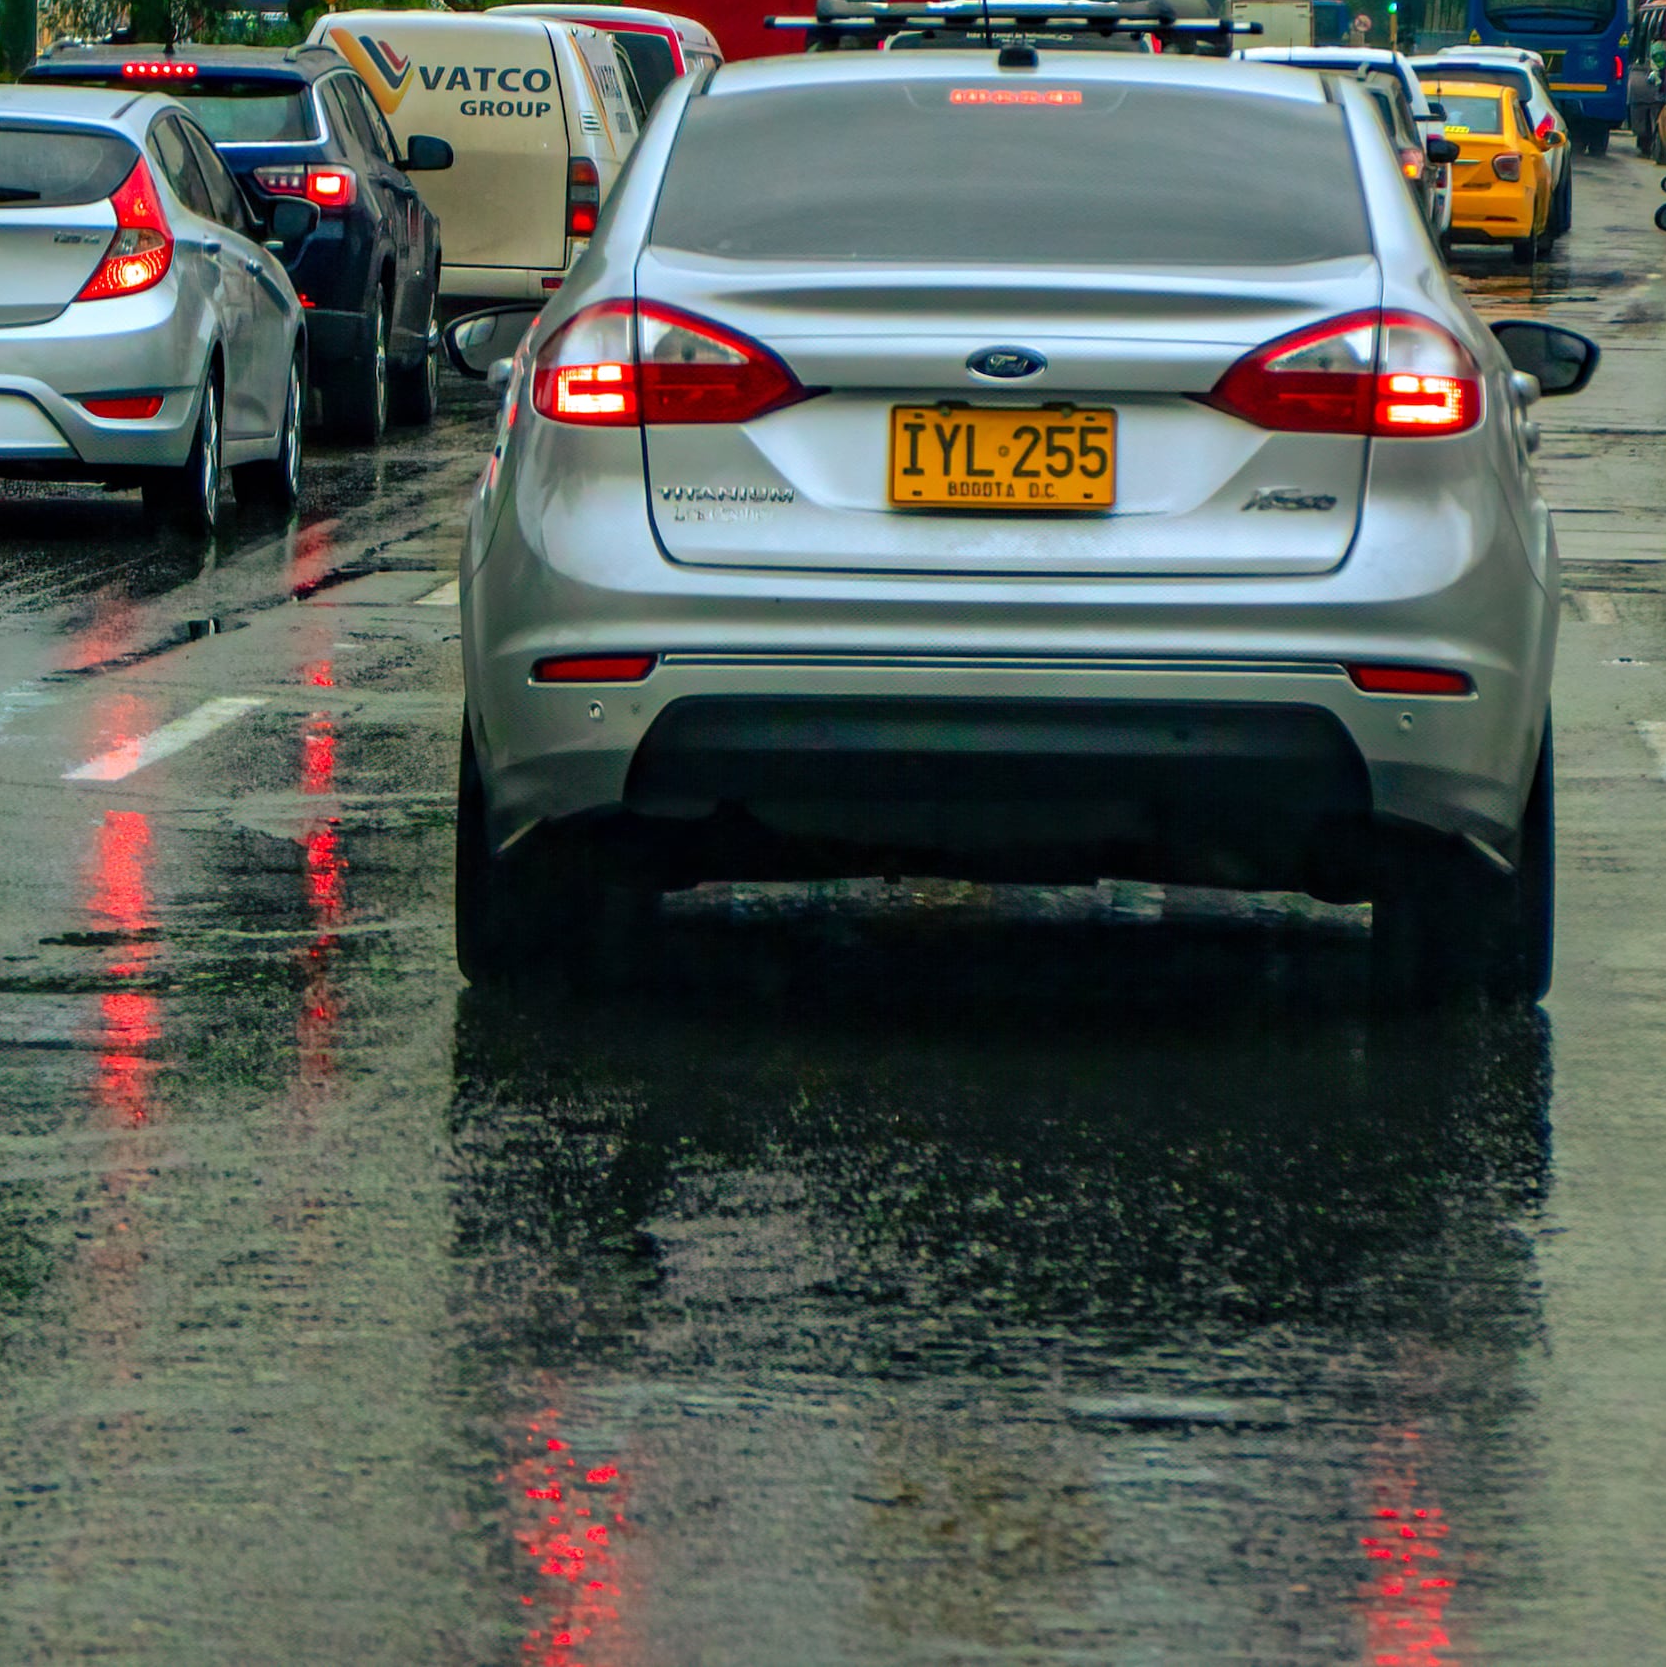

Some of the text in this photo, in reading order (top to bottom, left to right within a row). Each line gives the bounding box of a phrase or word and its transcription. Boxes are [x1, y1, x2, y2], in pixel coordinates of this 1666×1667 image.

[419, 66, 552, 93] VATCO
[460, 100, 551, 118] GROUP
[1012, 425, 1108, 479] 255
[658, 486, 795, 503] TITANIUM
[947, 481, 1015, 498] BOGOTA
